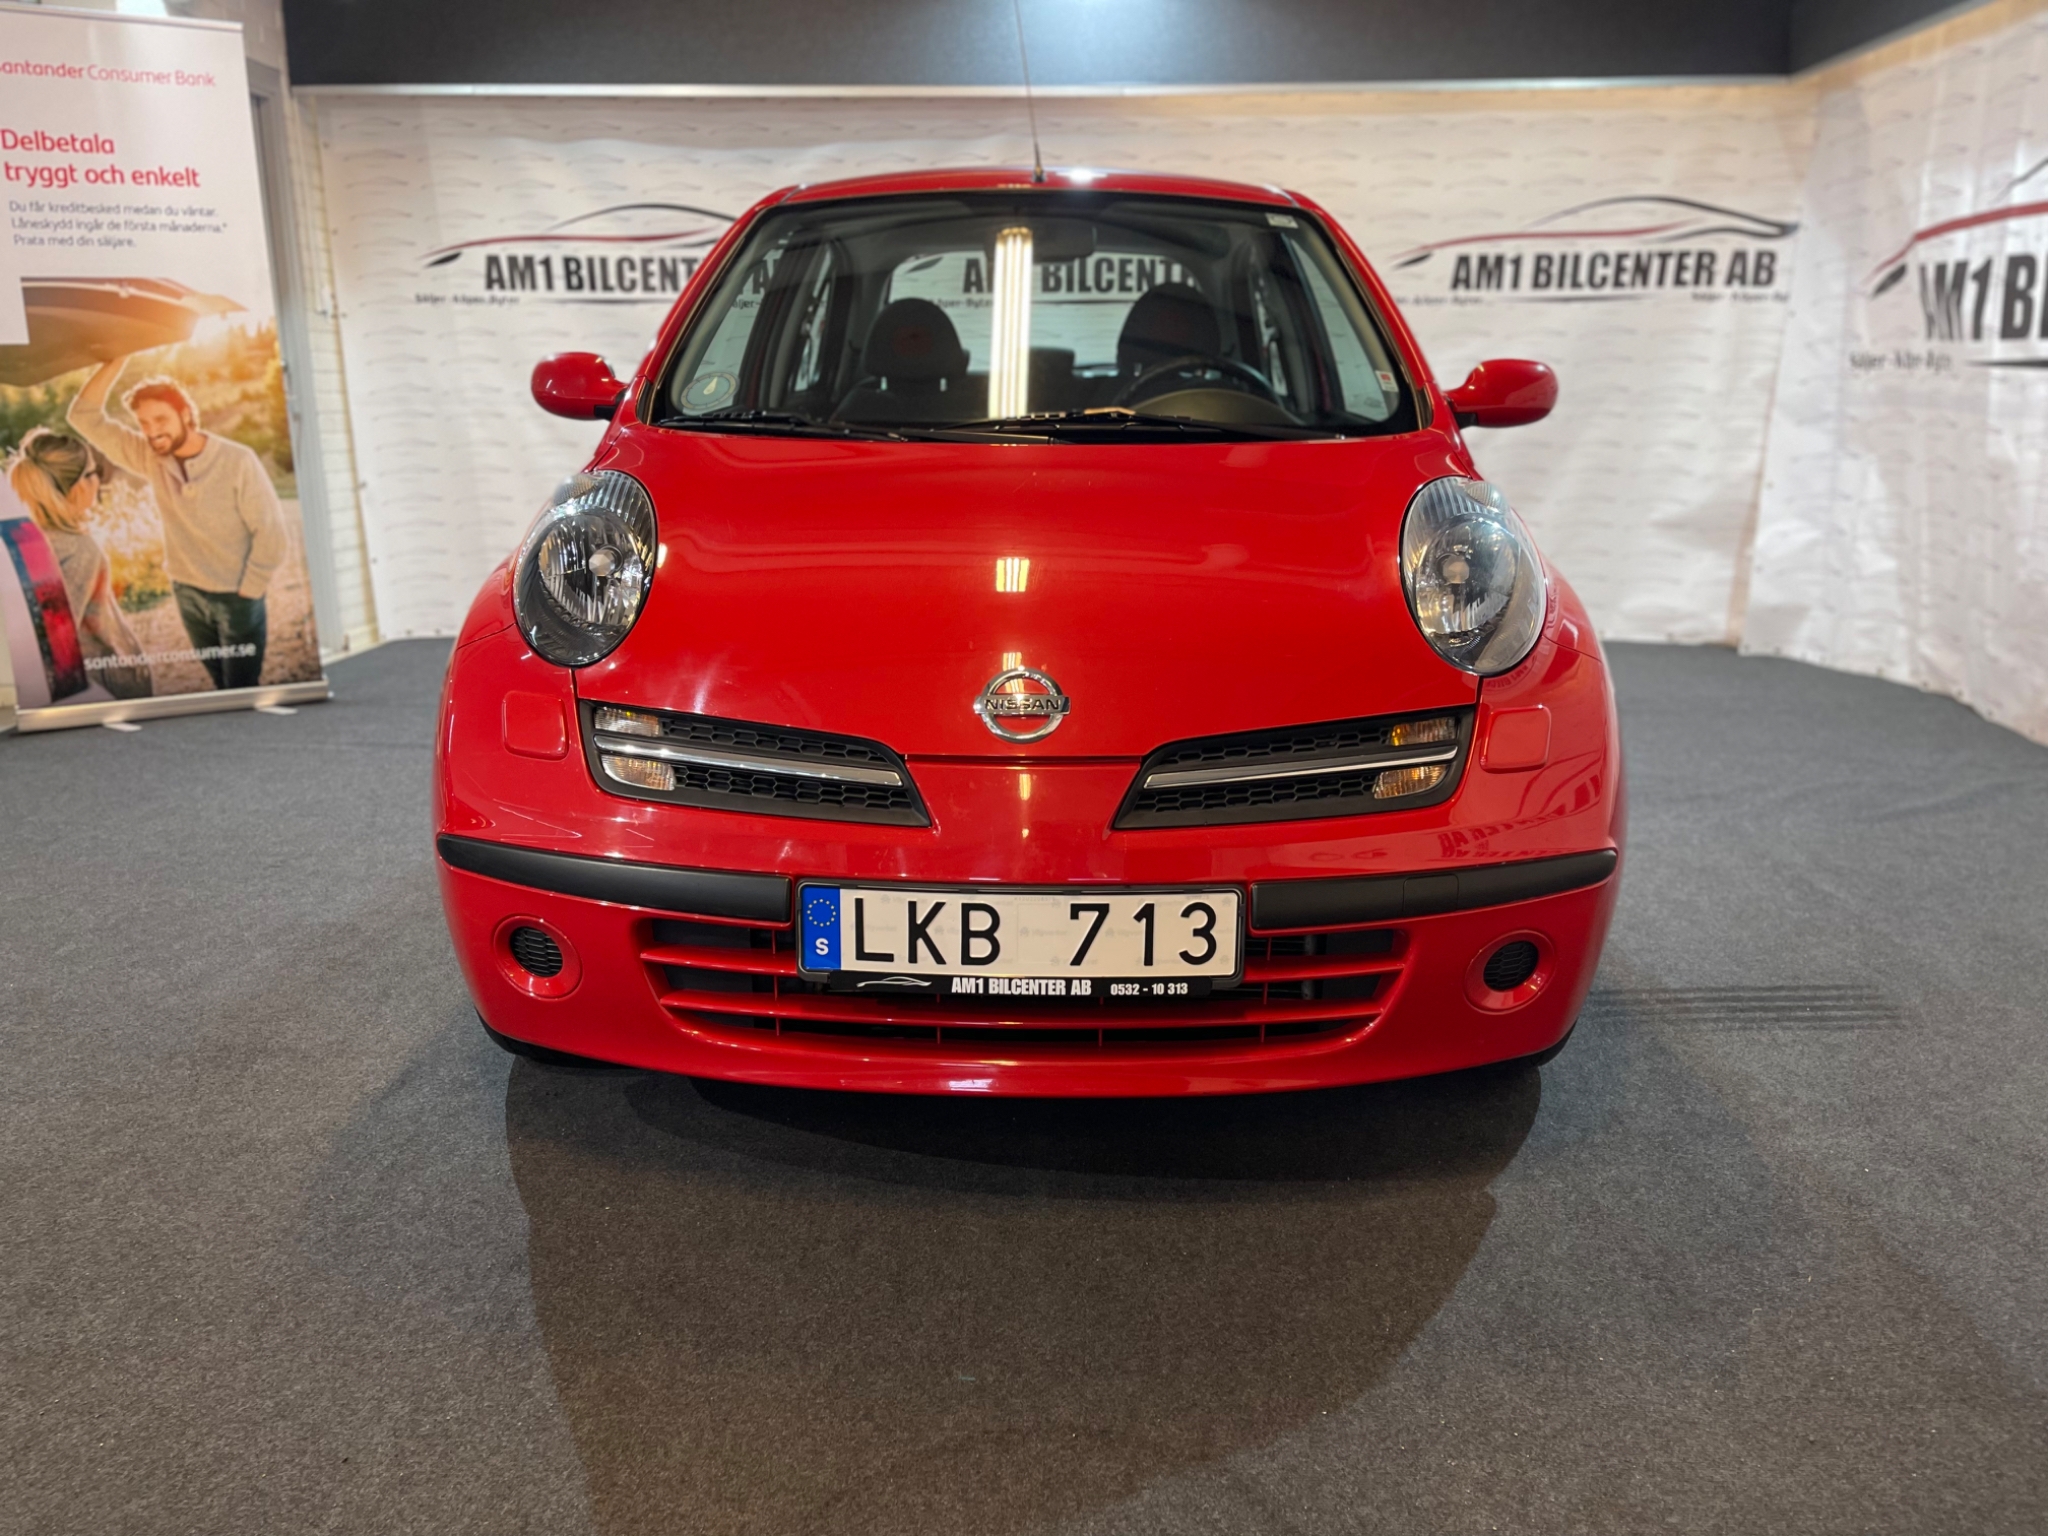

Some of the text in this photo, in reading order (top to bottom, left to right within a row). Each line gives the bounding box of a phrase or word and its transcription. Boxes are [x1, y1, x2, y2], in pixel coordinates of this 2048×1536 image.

[87, 64, 171, 84] Consumer
[175, 69, 215, 87] Bank
[1, 128, 115, 154] Delbetala
[4, 161, 201, 188] tryggt och enkelt
[9, 201, 27, 213] Du
[48, 201, 121, 215] kreditbesked
[123, 204, 162, 216] medan
[164, 204, 179, 217] du
[106, 219, 122, 231] de
[14, 234, 45, 246] Prata
[47, 235, 74, 247] med
[484, 254, 699, 293] AM1 BILCENT
[1451, 250, 1777, 291] AM1 BILCENTER AB
[83, 642, 256, 671] santanderconsumer.se
[984, 698, 1060, 711] NISSAN
[854, 897, 1217, 966] LKB 713
[815, 938, 829, 955] S
[951, 977, 984, 995] AM1
[988, 978, 1066, 996] BILCENTER
[1070, 979, 1092, 996] AB
[1110, 983, 1140, 996] 0532
[1151, 983, 1165, 996] 10
[1167, 983, 1189, 995] 313
